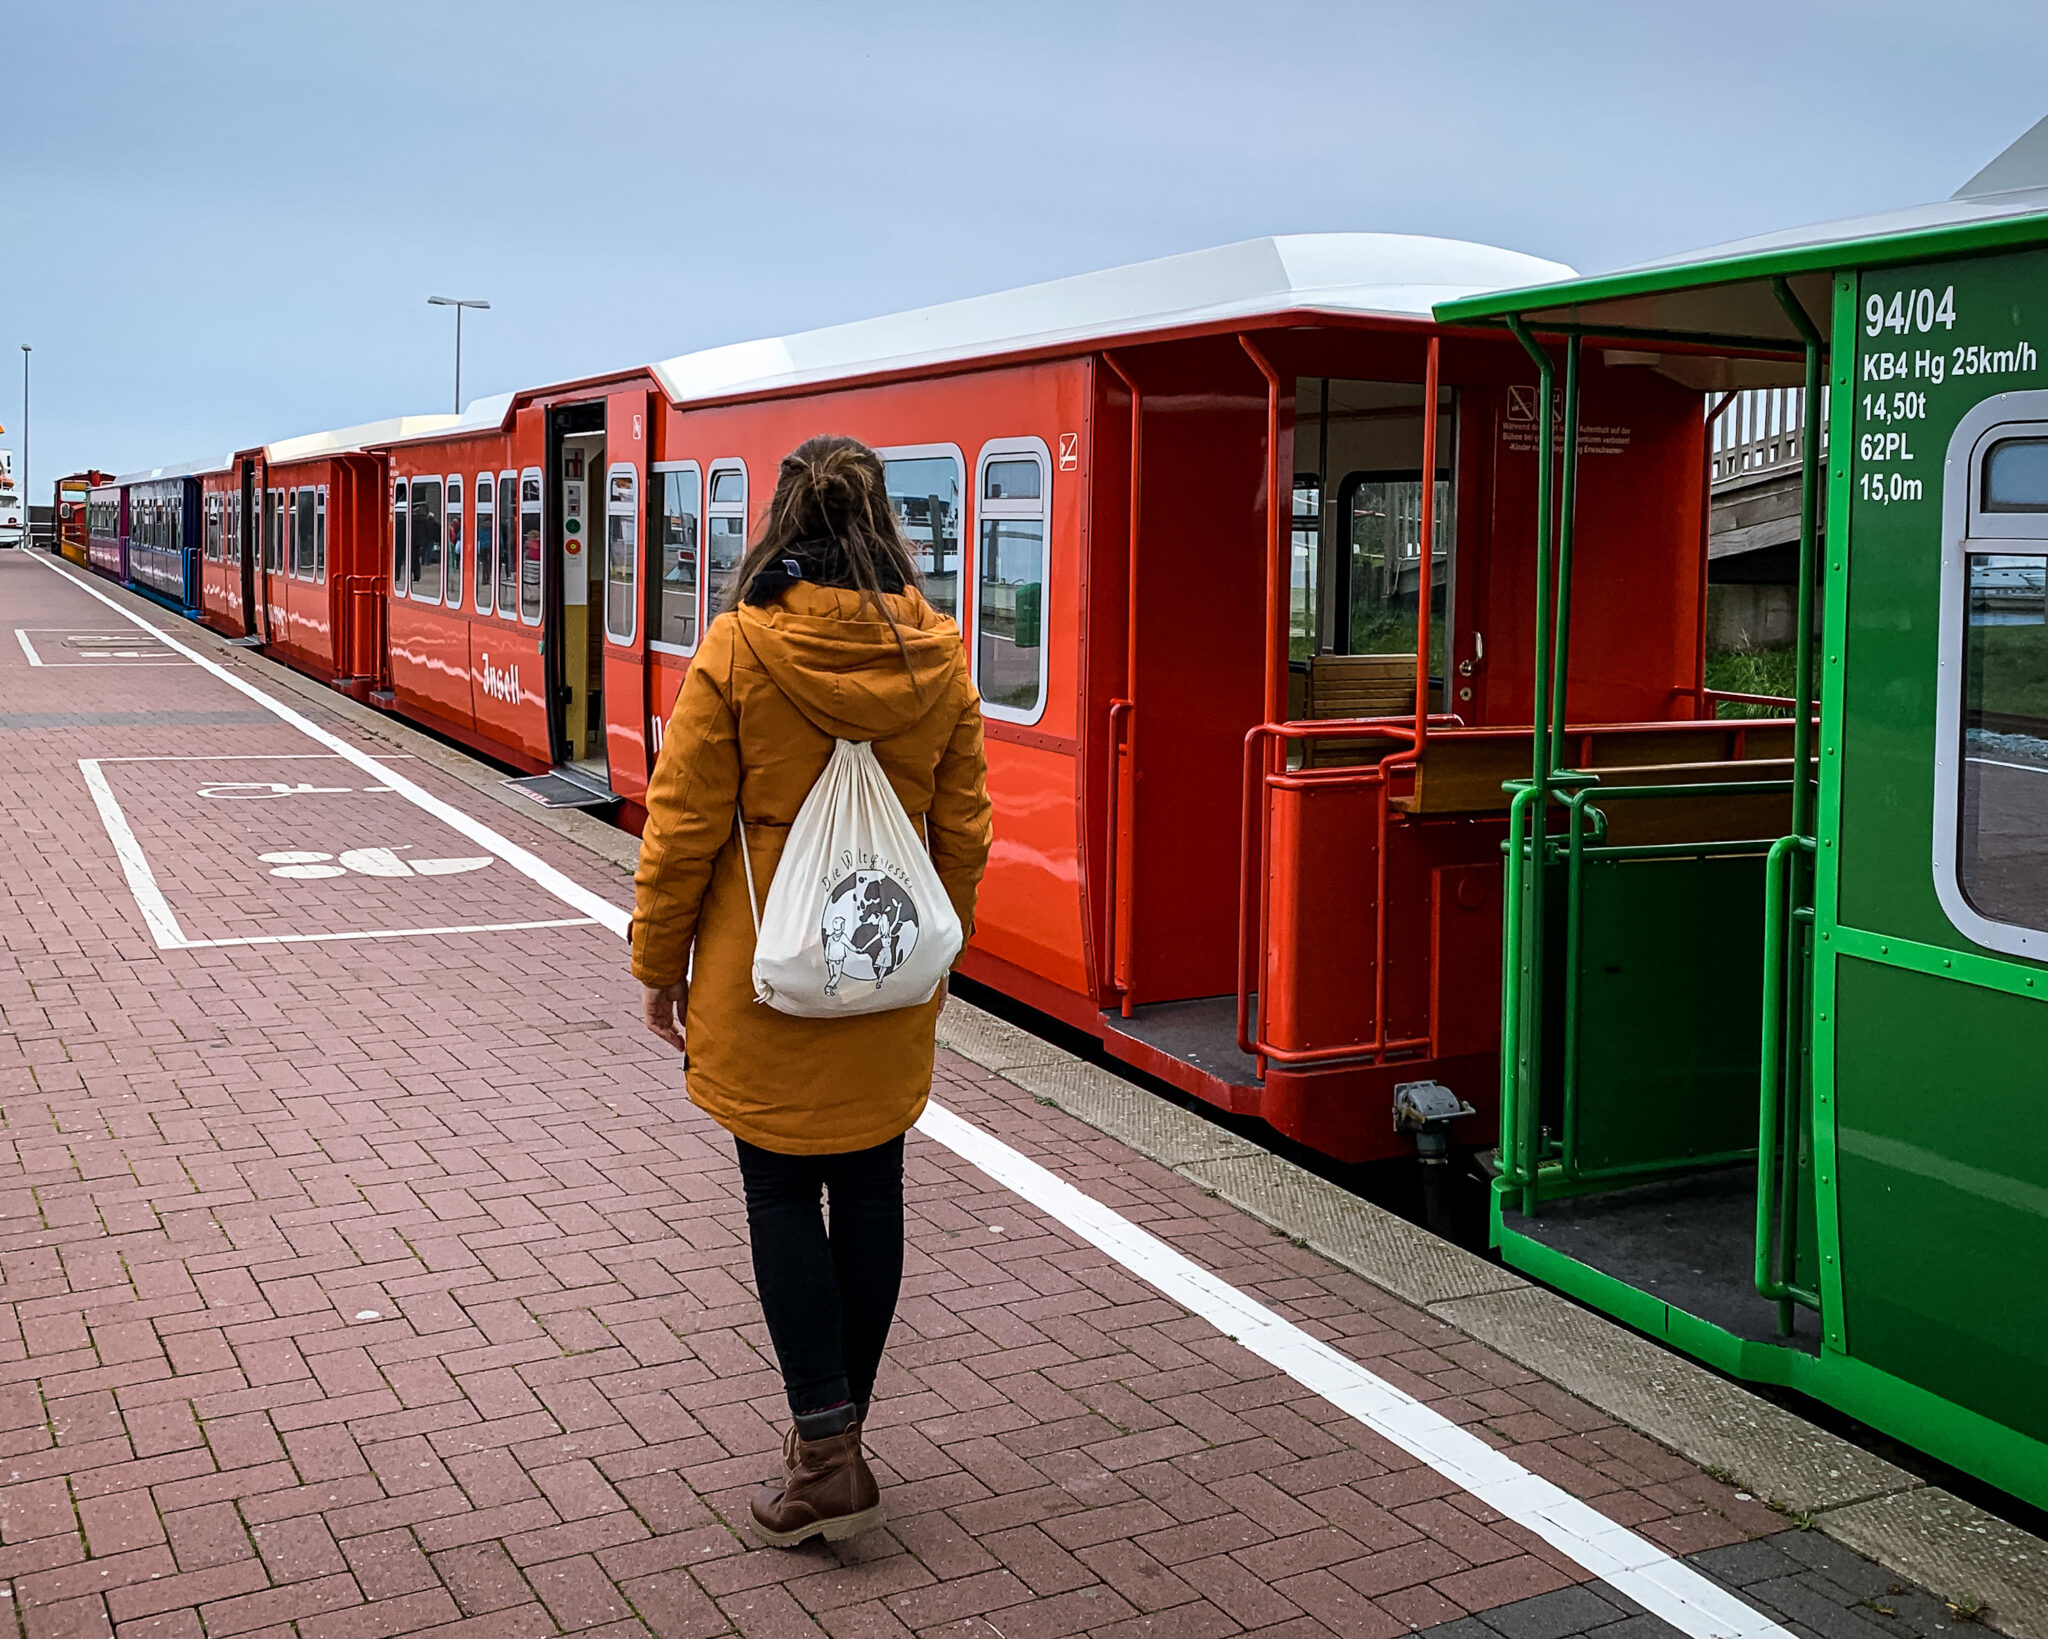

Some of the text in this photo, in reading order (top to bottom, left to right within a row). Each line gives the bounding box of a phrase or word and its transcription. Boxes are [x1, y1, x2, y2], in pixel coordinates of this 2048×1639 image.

[1865, 285, 1957, 337] 94/04
[1863, 341, 2037, 384] KB4 Hg 25km/h
[1862, 391, 1927, 425] 14,50t
[1860, 432, 1914, 461] 62PL
[1860, 472, 1923, 506] 15,0m
[822, 868, 841, 892] Die
